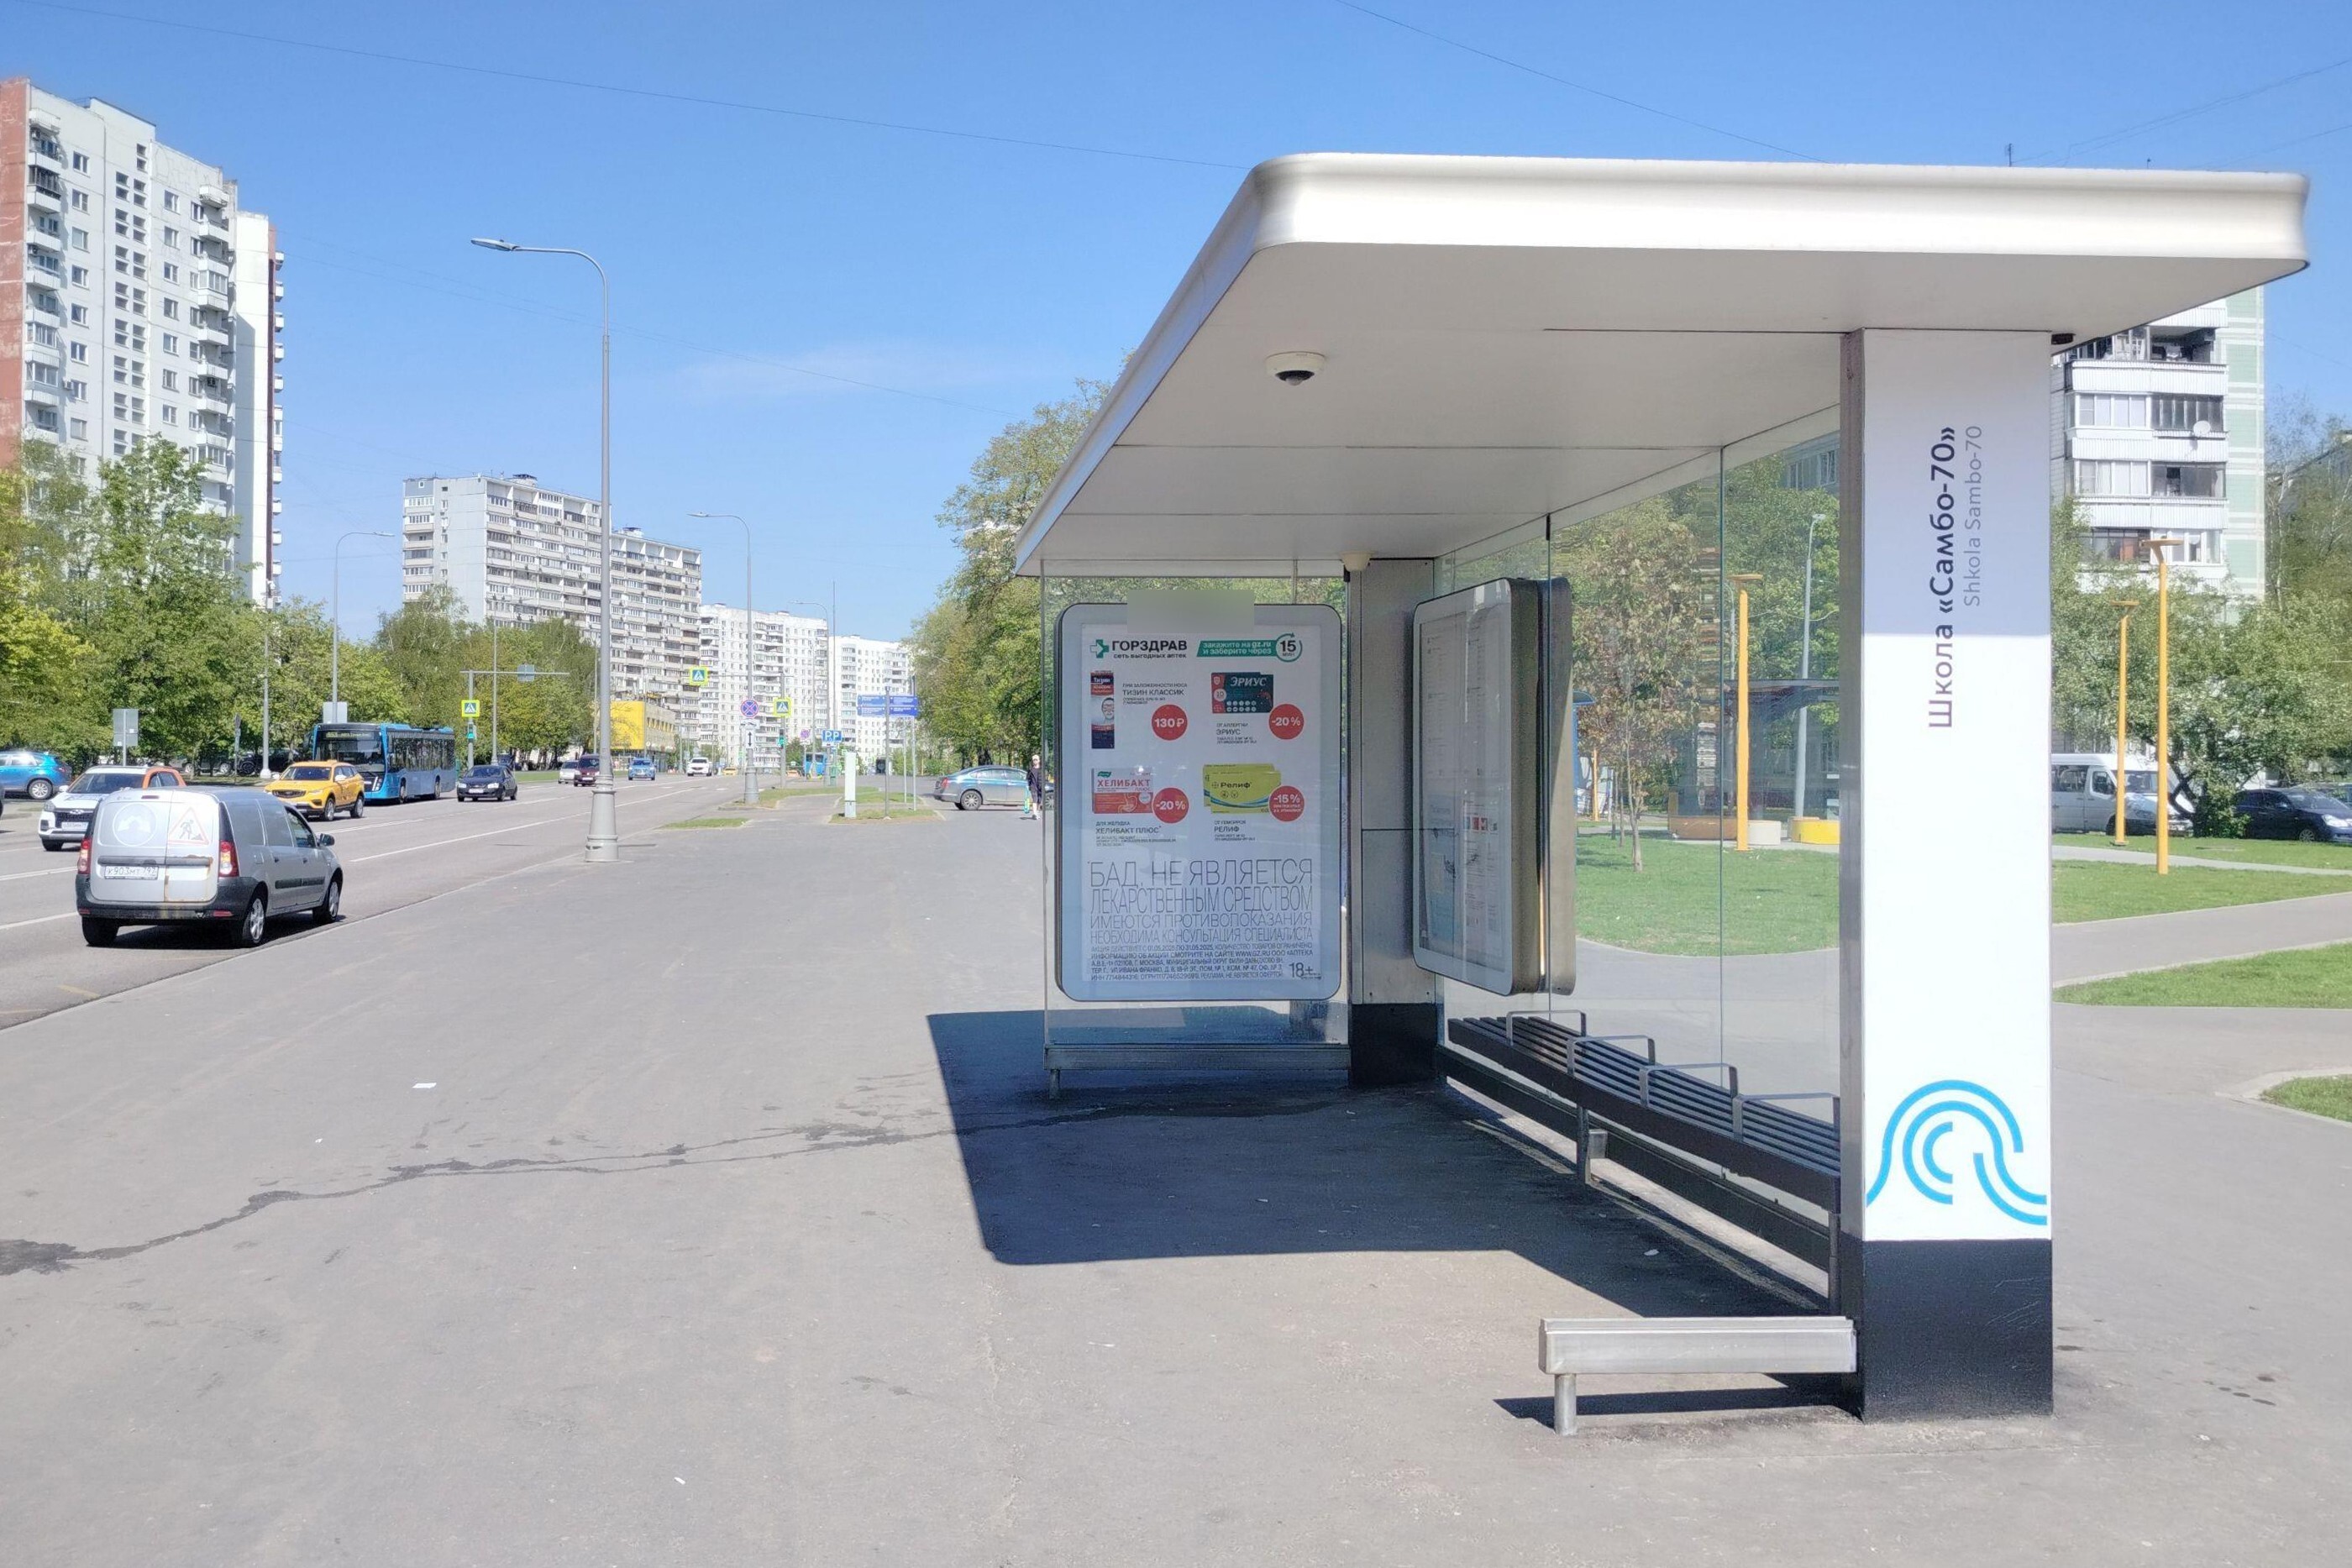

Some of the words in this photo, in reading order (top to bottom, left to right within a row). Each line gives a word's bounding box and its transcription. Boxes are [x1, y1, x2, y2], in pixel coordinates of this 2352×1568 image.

[1965, 426, 1982, 530] Sambo-70
[1929, 427, 1955, 613] «Самбо-70»
[1963, 537, 1981, 606] Shkola
[1112, 640, 1188, 653] ГОРЗДРАВ
[1279, 640, 1297, 653] 15
[1231, 676, 1268, 687] ЭРИУС
[1929, 624, 1953, 727] Школа
[1097, 779, 1151, 787] ХЕЛИБАКТ
[1152, 860, 1182, 886] НЕ
[1189, 858, 1312, 886] ЯВЛЯЕТСЯ
[1090, 887, 1220, 915] ЛЕКАРСТВЕННЫМ
[1223, 885, 1313, 913] СРЕДСТВОМ
[1090, 915, 1161, 929] ИМЕЮТСЯ
[1164, 912, 1312, 928] ПРОТИВОПОКАЗАНИЯ
[1090, 929, 1161, 944] НЕОБХОДИМА
[1163, 927, 1242, 943] КОНСУЛЬТАЦИЯ
[1244, 927, 1313, 941] СПЕЦИАЛИСТА
[1289, 962, 1314, 978] 18+
